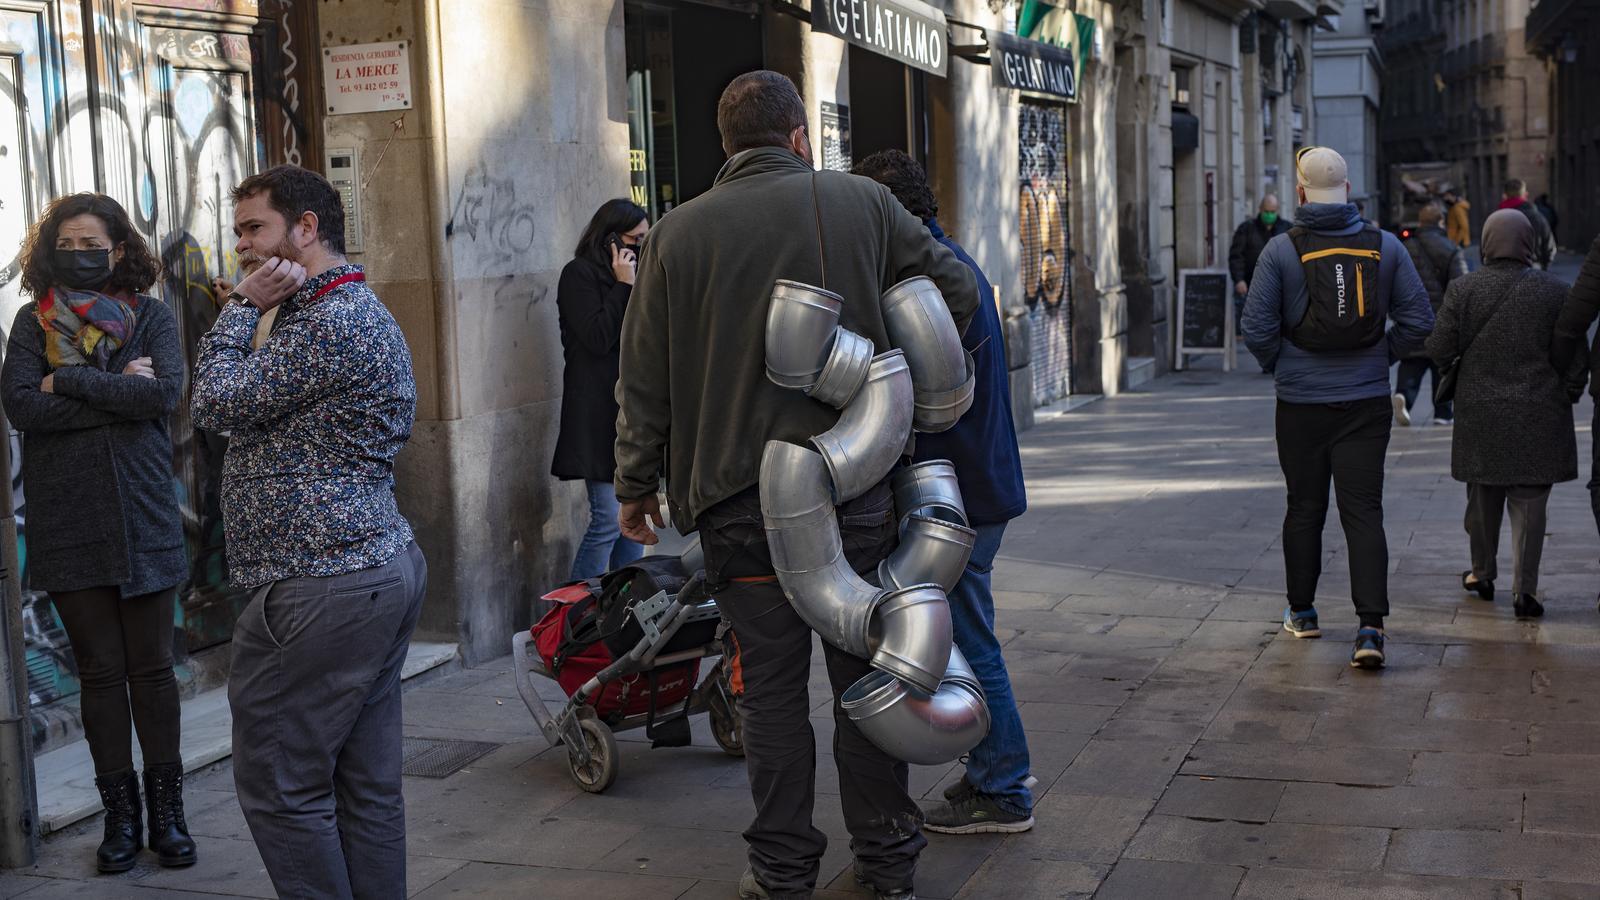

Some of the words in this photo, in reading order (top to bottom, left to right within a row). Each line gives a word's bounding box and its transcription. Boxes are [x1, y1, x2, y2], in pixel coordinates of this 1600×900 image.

[833, 0, 941, 68] GELATIAMO
[366, 50, 401, 59] GERIATRICA
[336, 68, 351, 79] LA
[356, 63, 398, 78] MERCE
[1004, 52, 1075, 96] GELATIAMO
[364, 83, 377, 91] 412
[1335, 263, 1346, 318] ONETOALL
